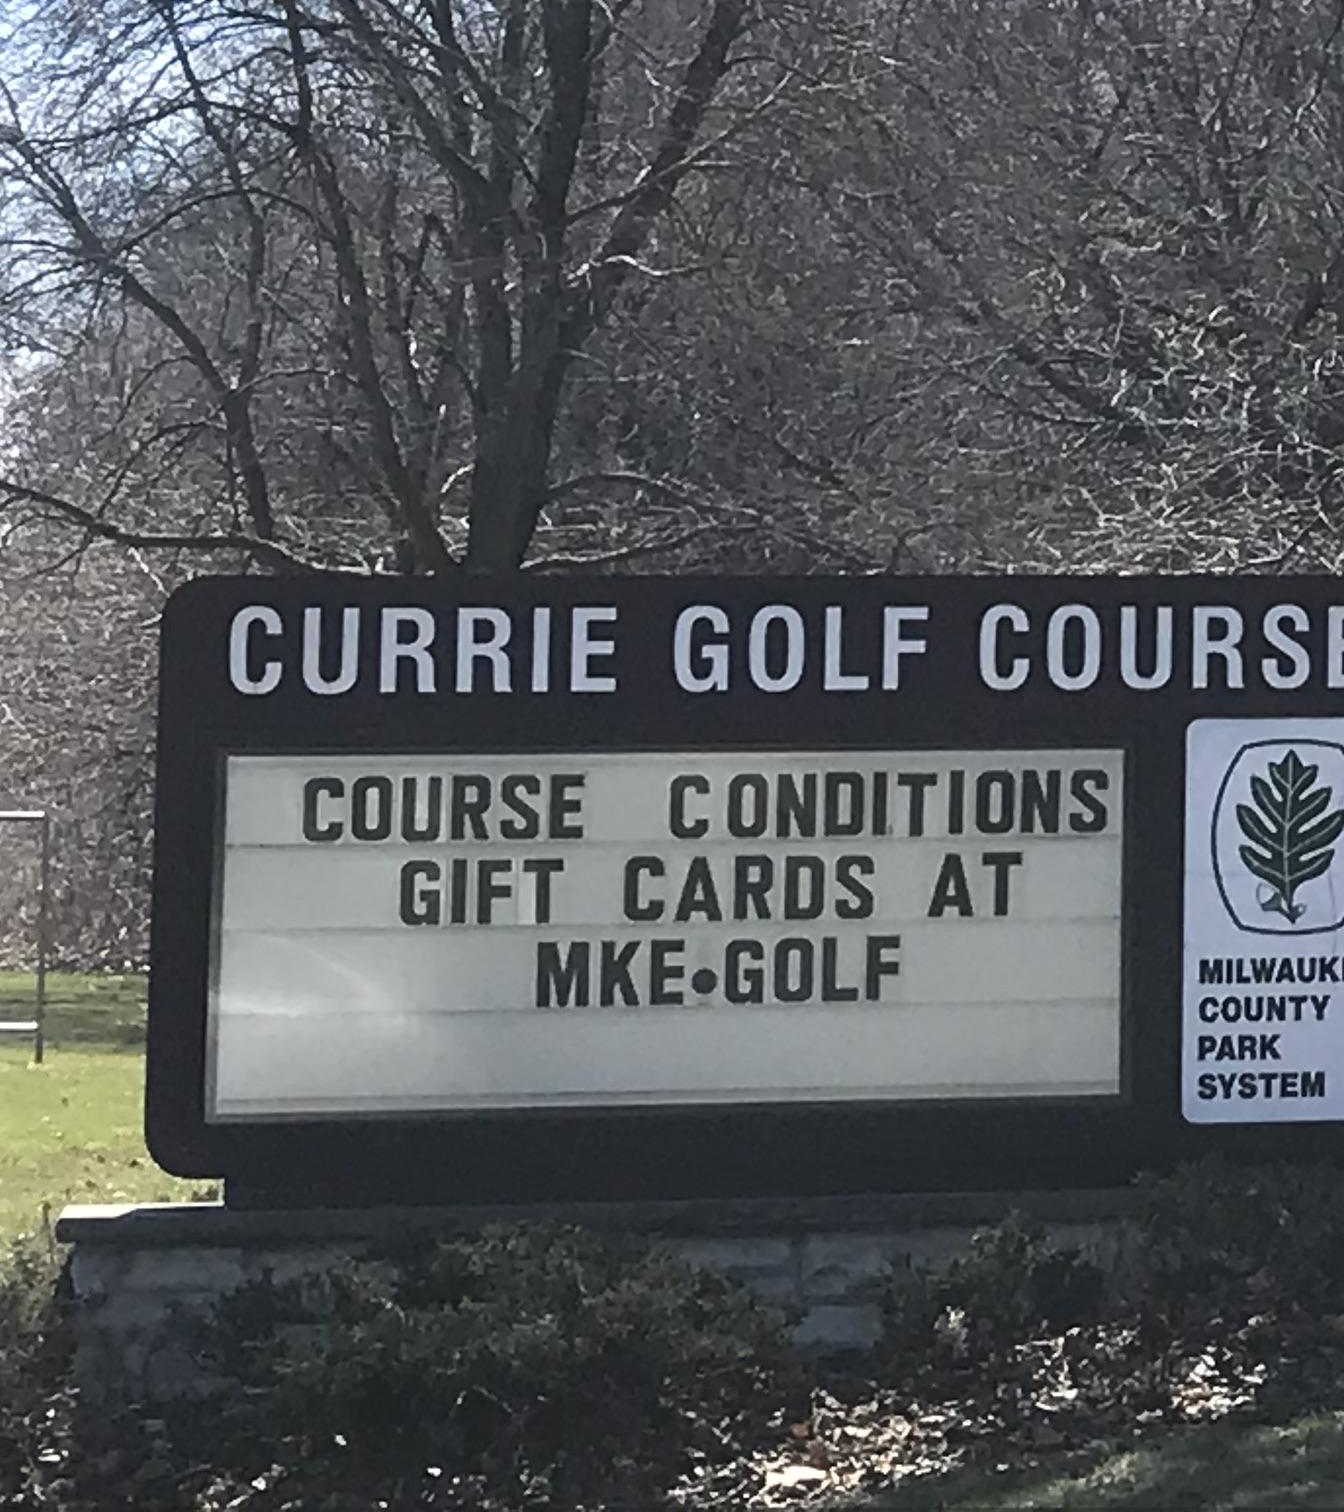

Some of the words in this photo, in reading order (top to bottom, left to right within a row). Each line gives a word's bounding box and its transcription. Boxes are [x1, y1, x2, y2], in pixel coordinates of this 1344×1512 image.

[229, 604, 618, 695] CURRIE
[674, 604, 931, 692] GOLF
[302, 773, 585, 843] COURSE
[669, 768, 1109, 840] CONDITIONS
[398, 858, 565, 926] GIFT
[623, 853, 877, 923] CARDS
[928, 850, 1024, 918] AT
[1198, 995, 1332, 1025] COUNTY
[1198, 1035, 1282, 1064] PARK
[1197, 1071, 1327, 1101] SYSTEM
